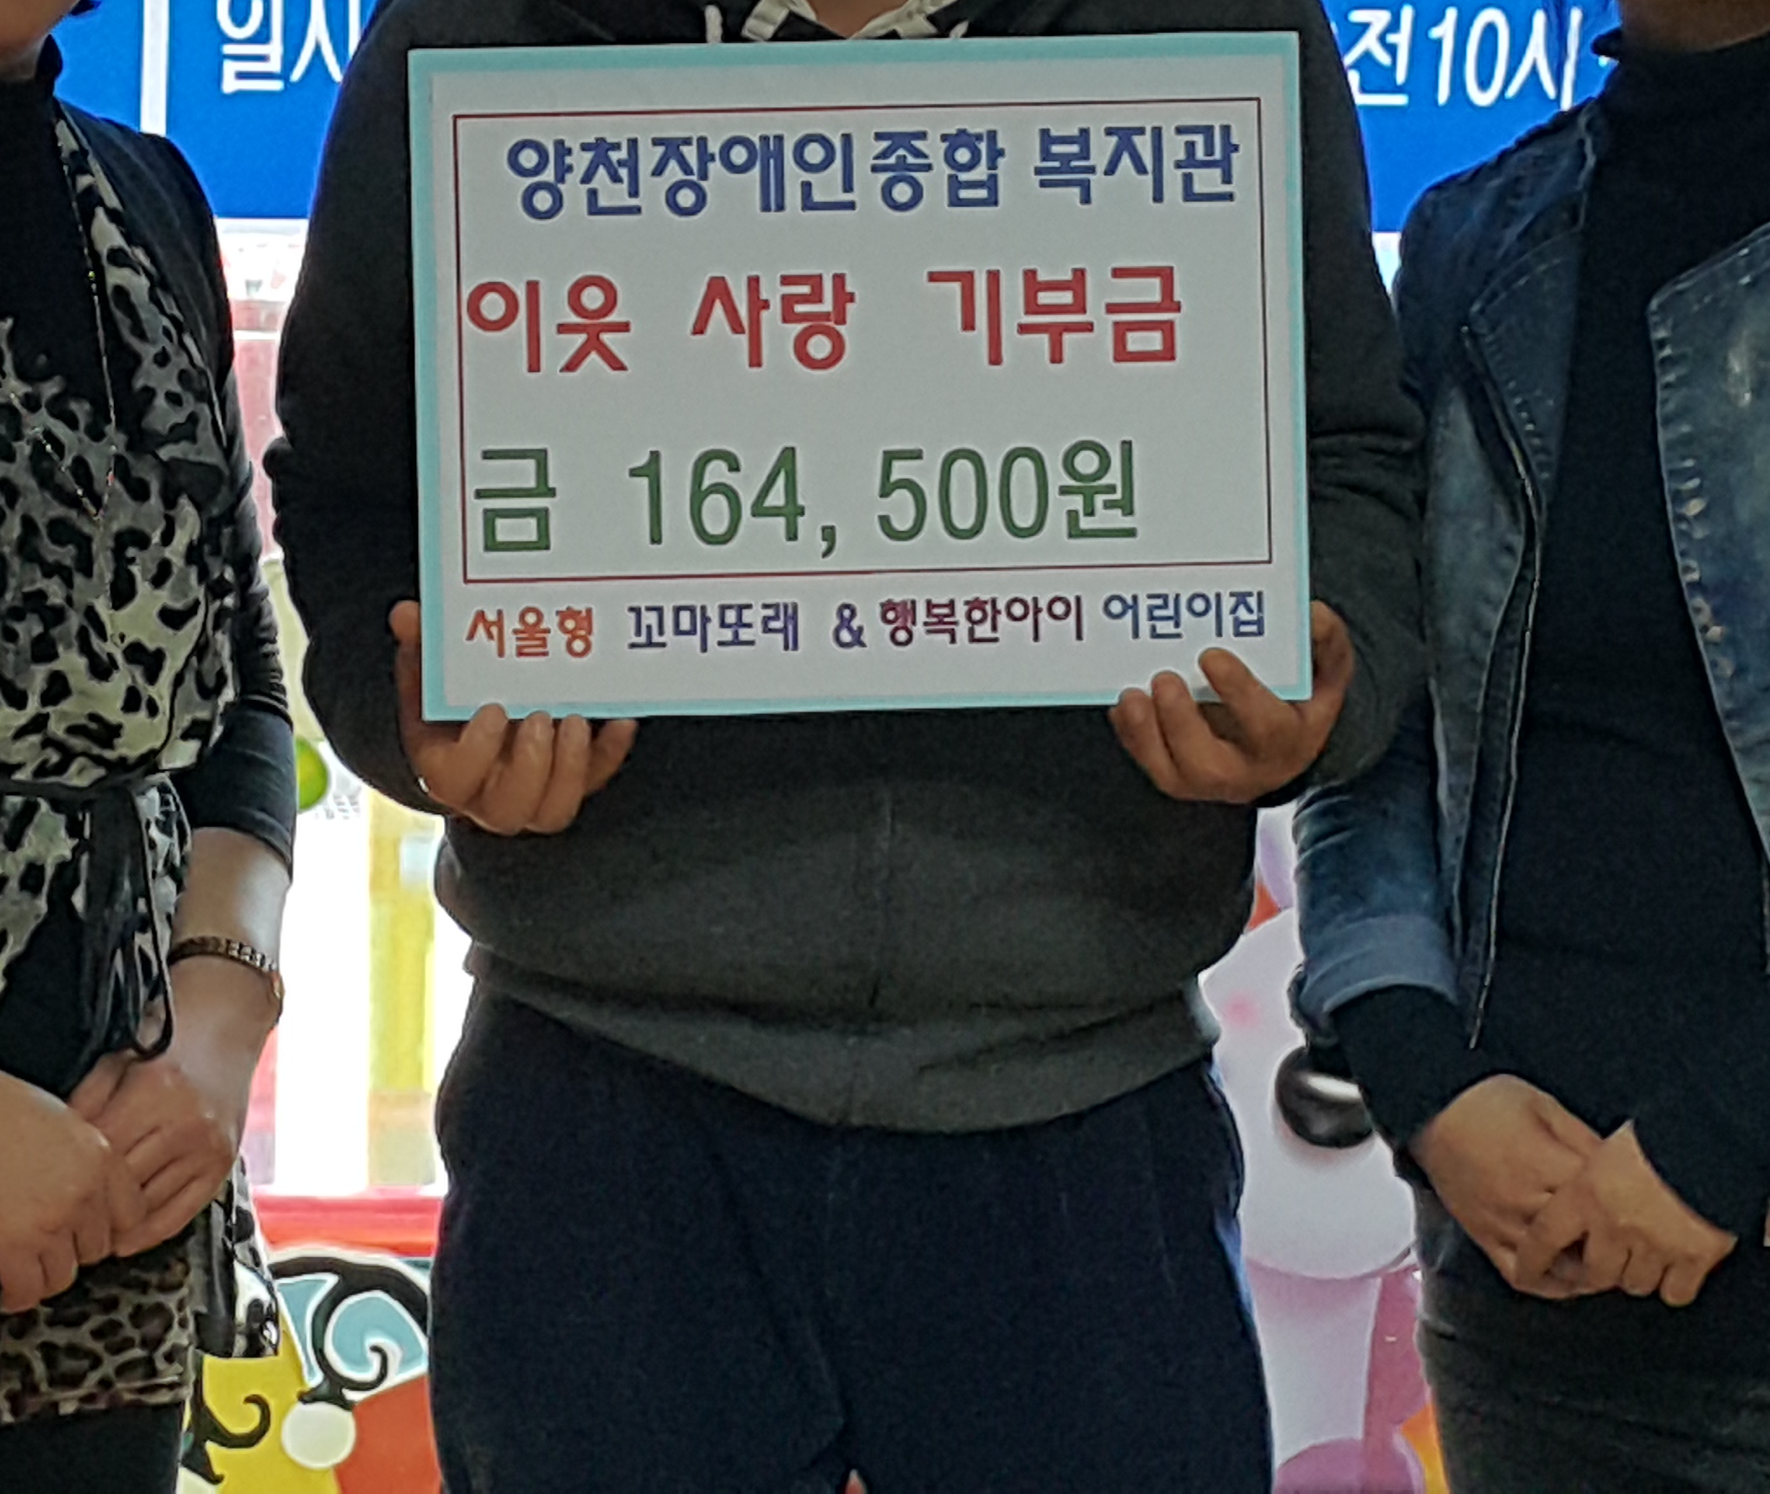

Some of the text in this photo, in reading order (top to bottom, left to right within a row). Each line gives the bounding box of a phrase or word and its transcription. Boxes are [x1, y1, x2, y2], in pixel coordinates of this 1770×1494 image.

[508, 125, 1239, 220] 양천장애인종합 복지관
[467, 266, 1181, 373] 이웃 사랑 기부금
[474, 448, 557, 552] 금
[466, 606, 593, 658] 서울형
[627, 602, 799, 654] 꼬마또래
[1103, 591, 1265, 646] 어린이집
